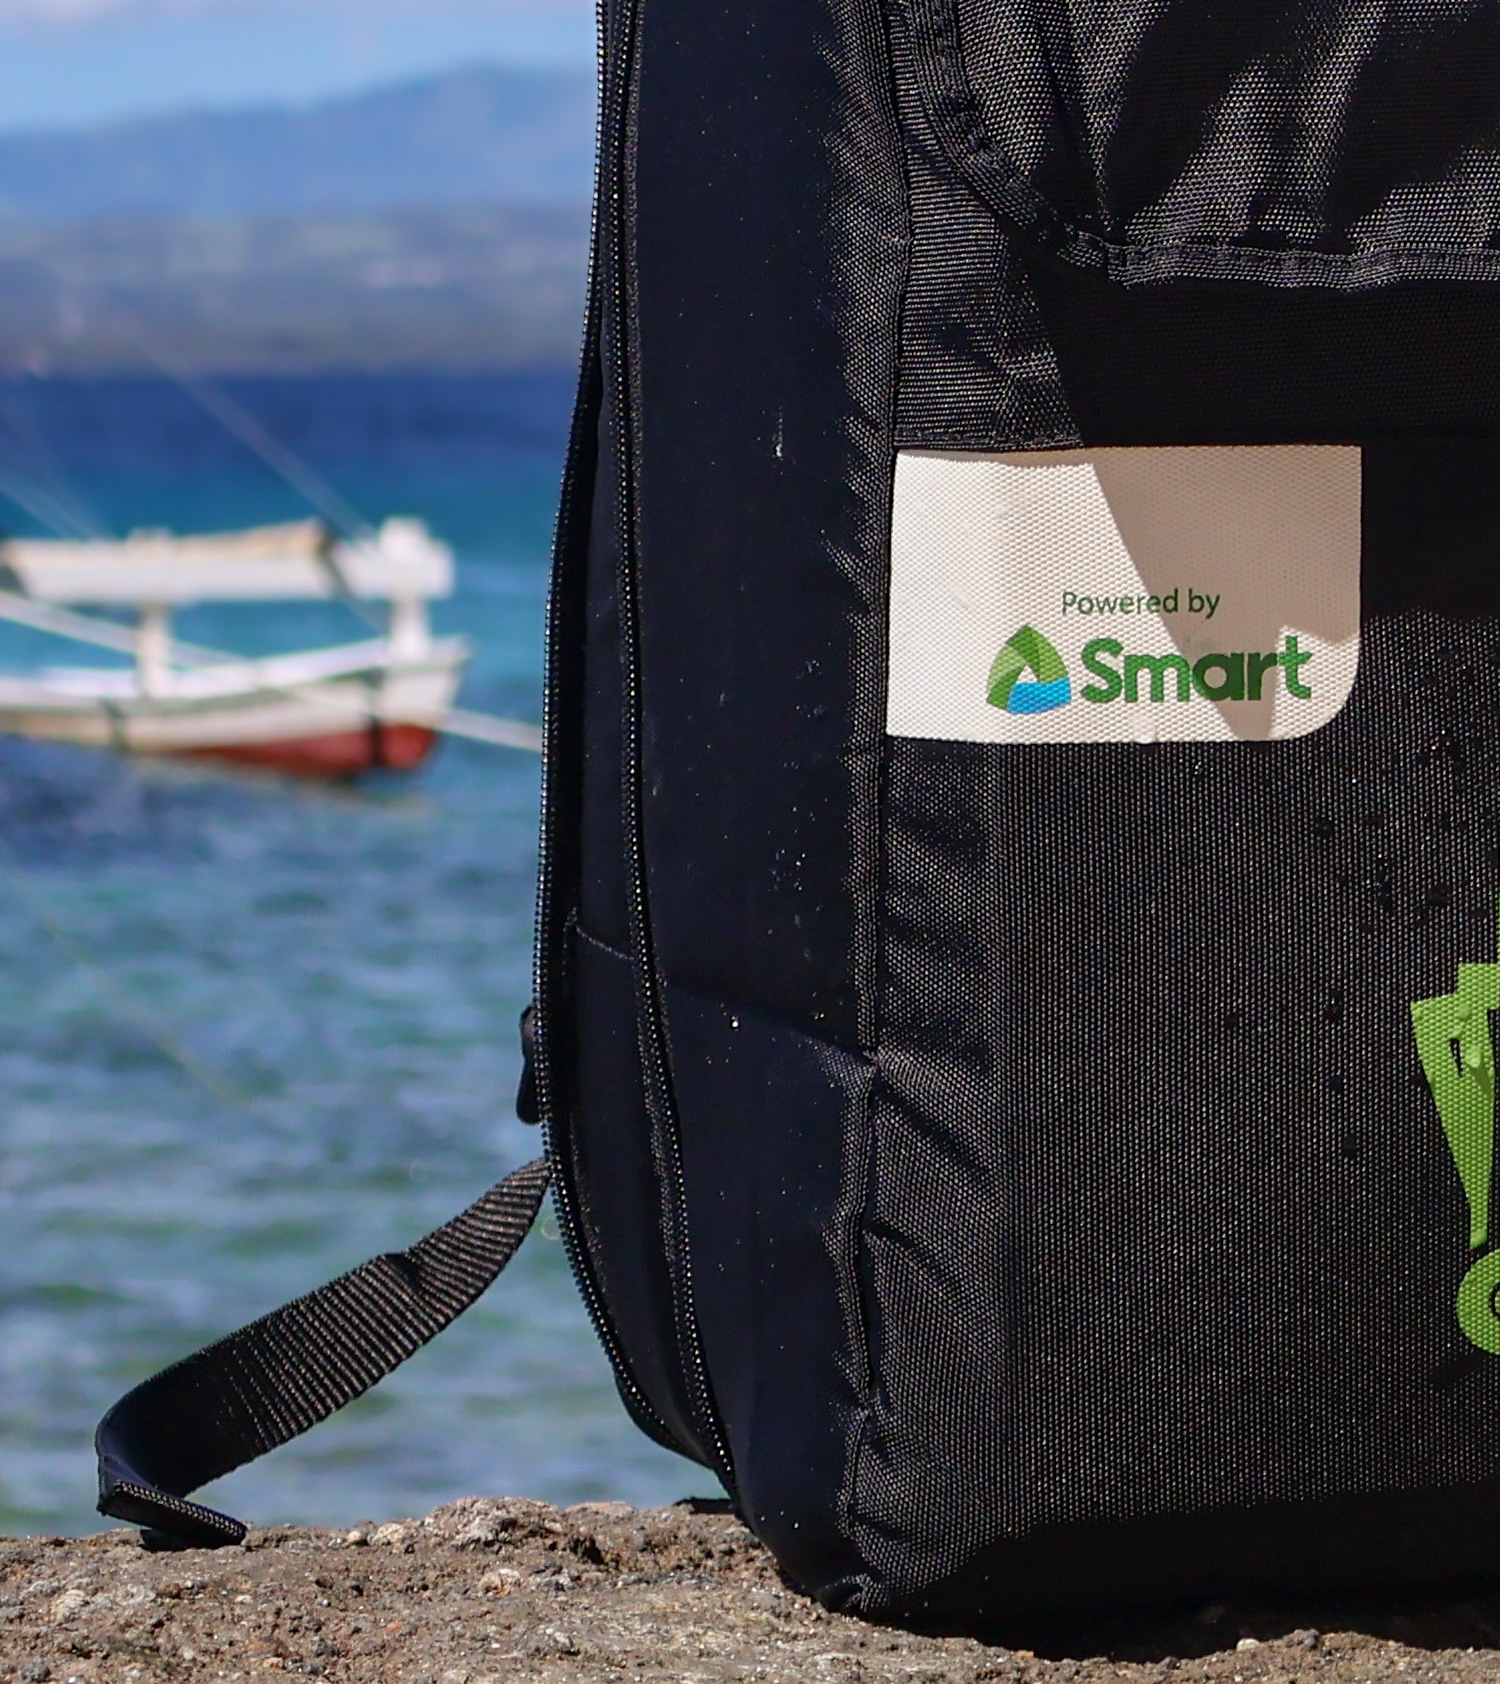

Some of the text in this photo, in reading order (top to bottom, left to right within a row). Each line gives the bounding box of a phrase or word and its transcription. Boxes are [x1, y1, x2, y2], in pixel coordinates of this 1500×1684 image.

[1060, 587, 1221, 619] Powered by
[1080, 634, 1314, 705] Smart
